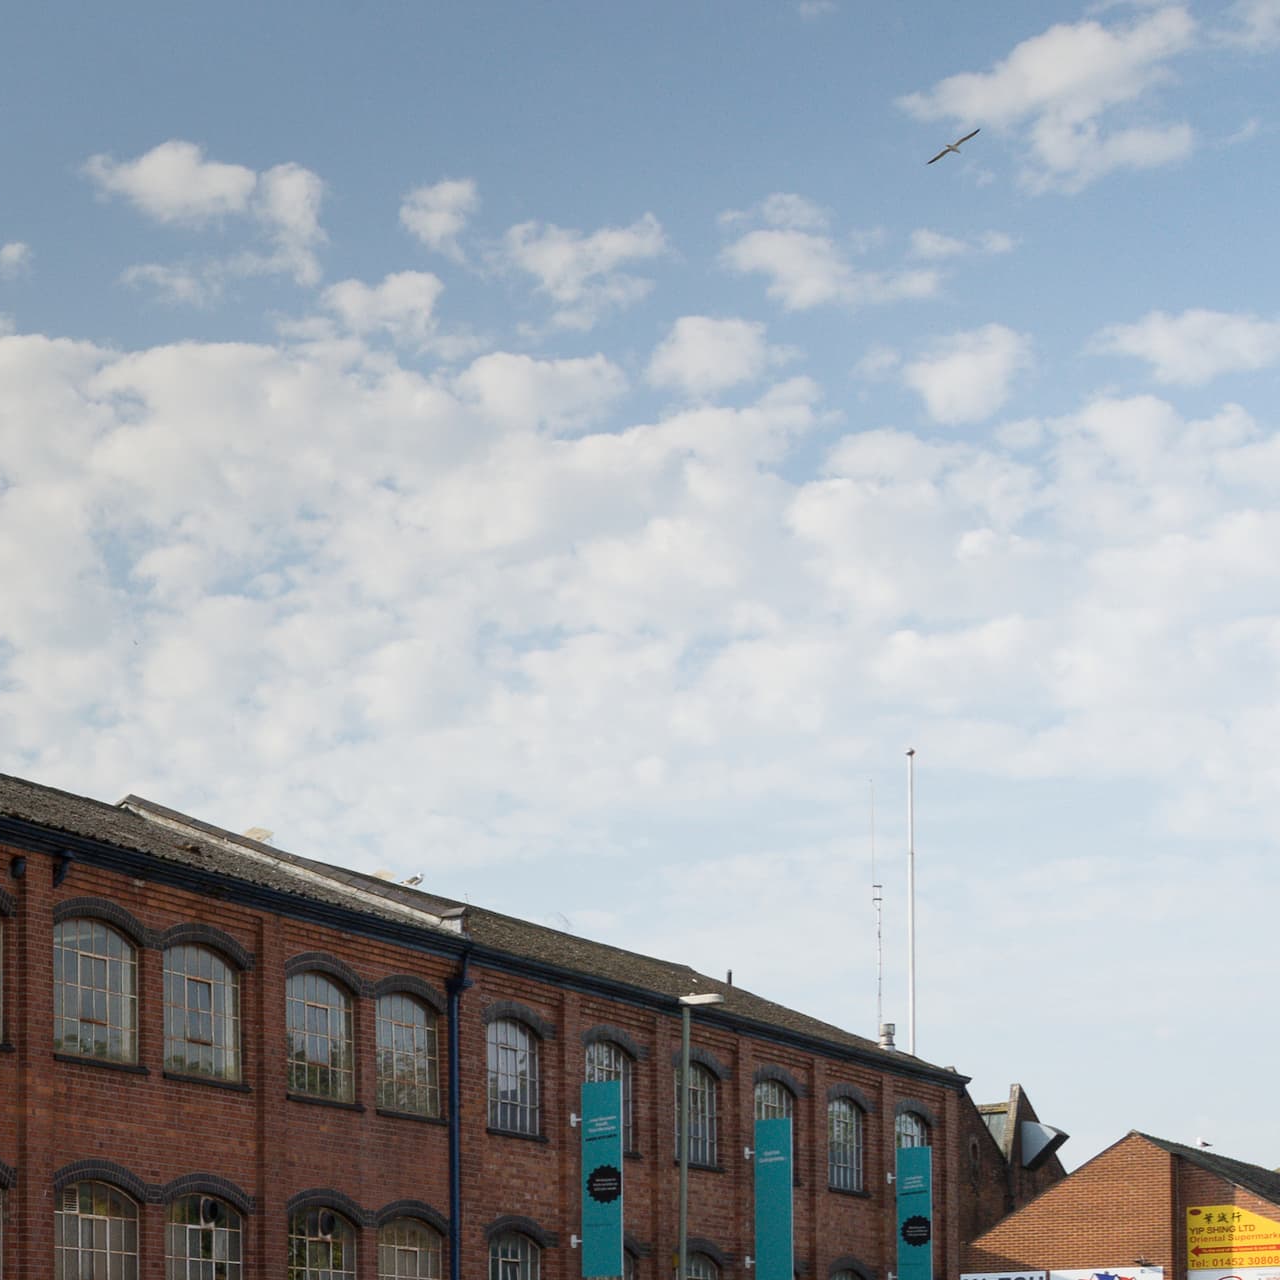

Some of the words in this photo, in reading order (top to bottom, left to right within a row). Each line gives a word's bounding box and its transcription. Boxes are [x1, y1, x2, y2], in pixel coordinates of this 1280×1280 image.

[1190, 1227, 1205, 1235] YIP
[1238, 1224, 1256, 1232] LTD
[1190, 1259, 1208, 1267] Tel:
[1212, 1258, 1244, 1267] 01452
